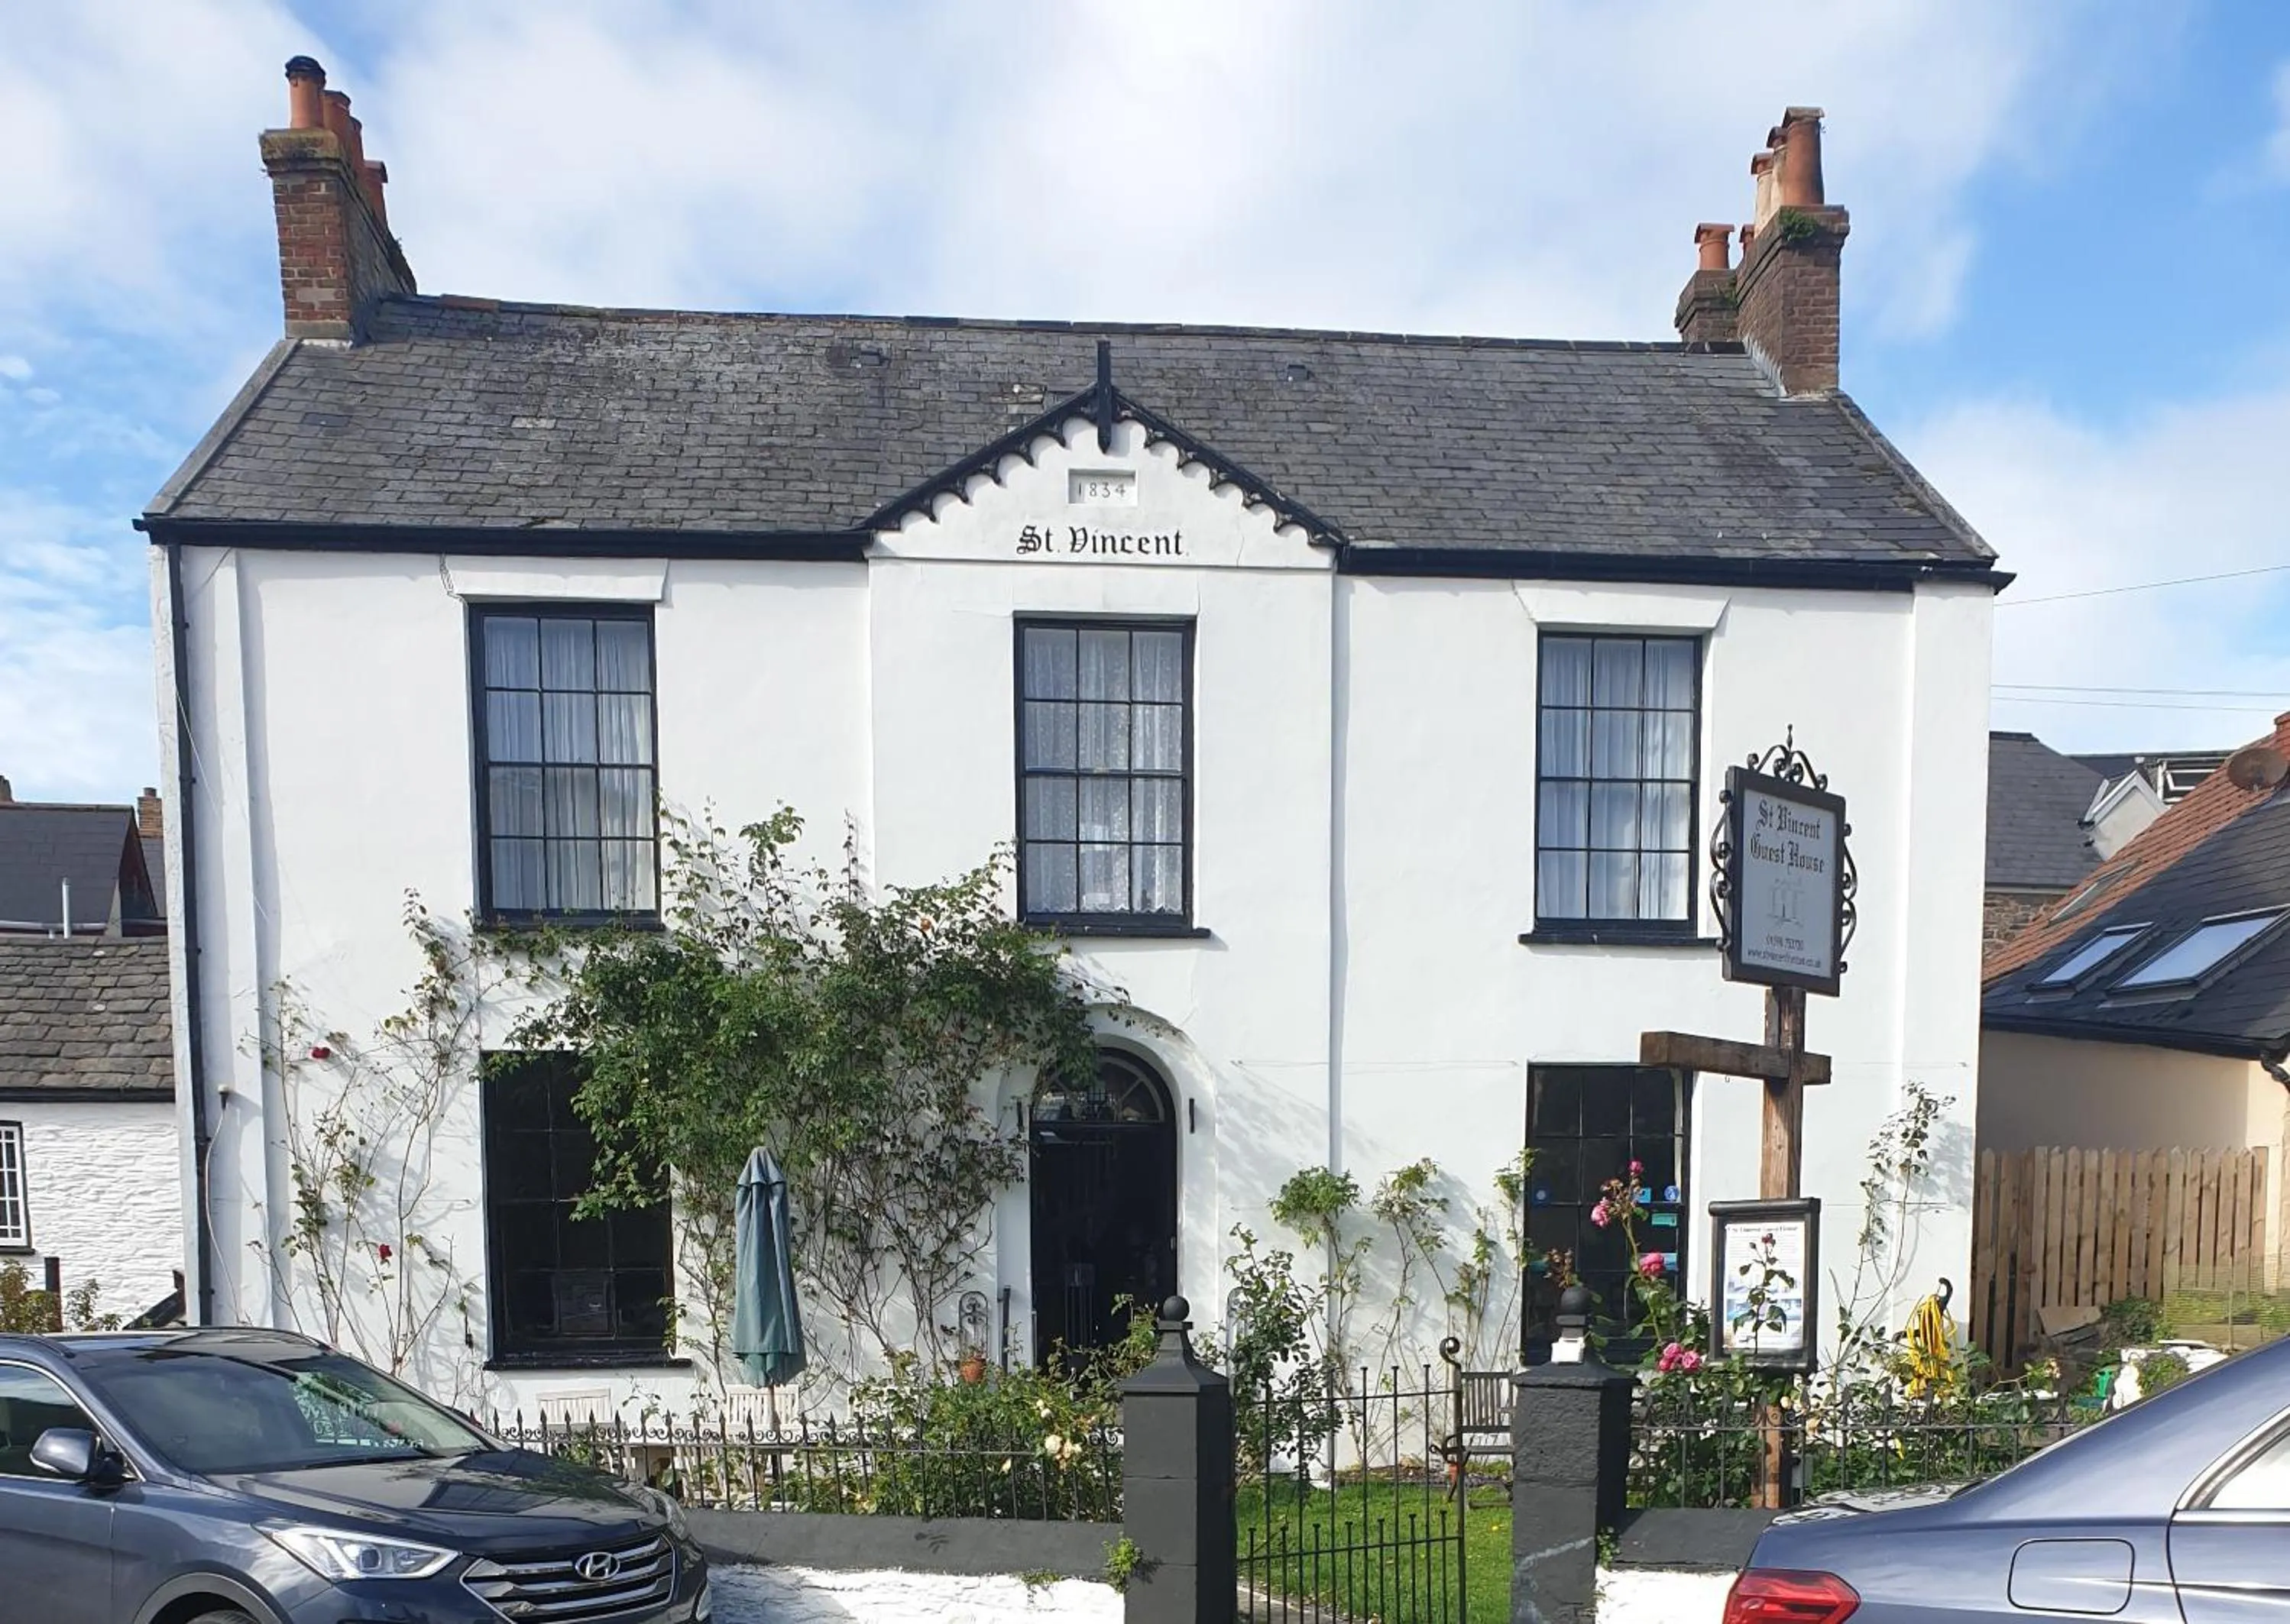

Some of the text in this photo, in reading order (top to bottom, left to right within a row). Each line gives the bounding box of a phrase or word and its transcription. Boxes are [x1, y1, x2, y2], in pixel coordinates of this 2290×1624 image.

[1078, 481, 1126, 499] 1834
[1756, 799, 1821, 839] St Vincent
[1751, 832, 1825, 875] Guest House
